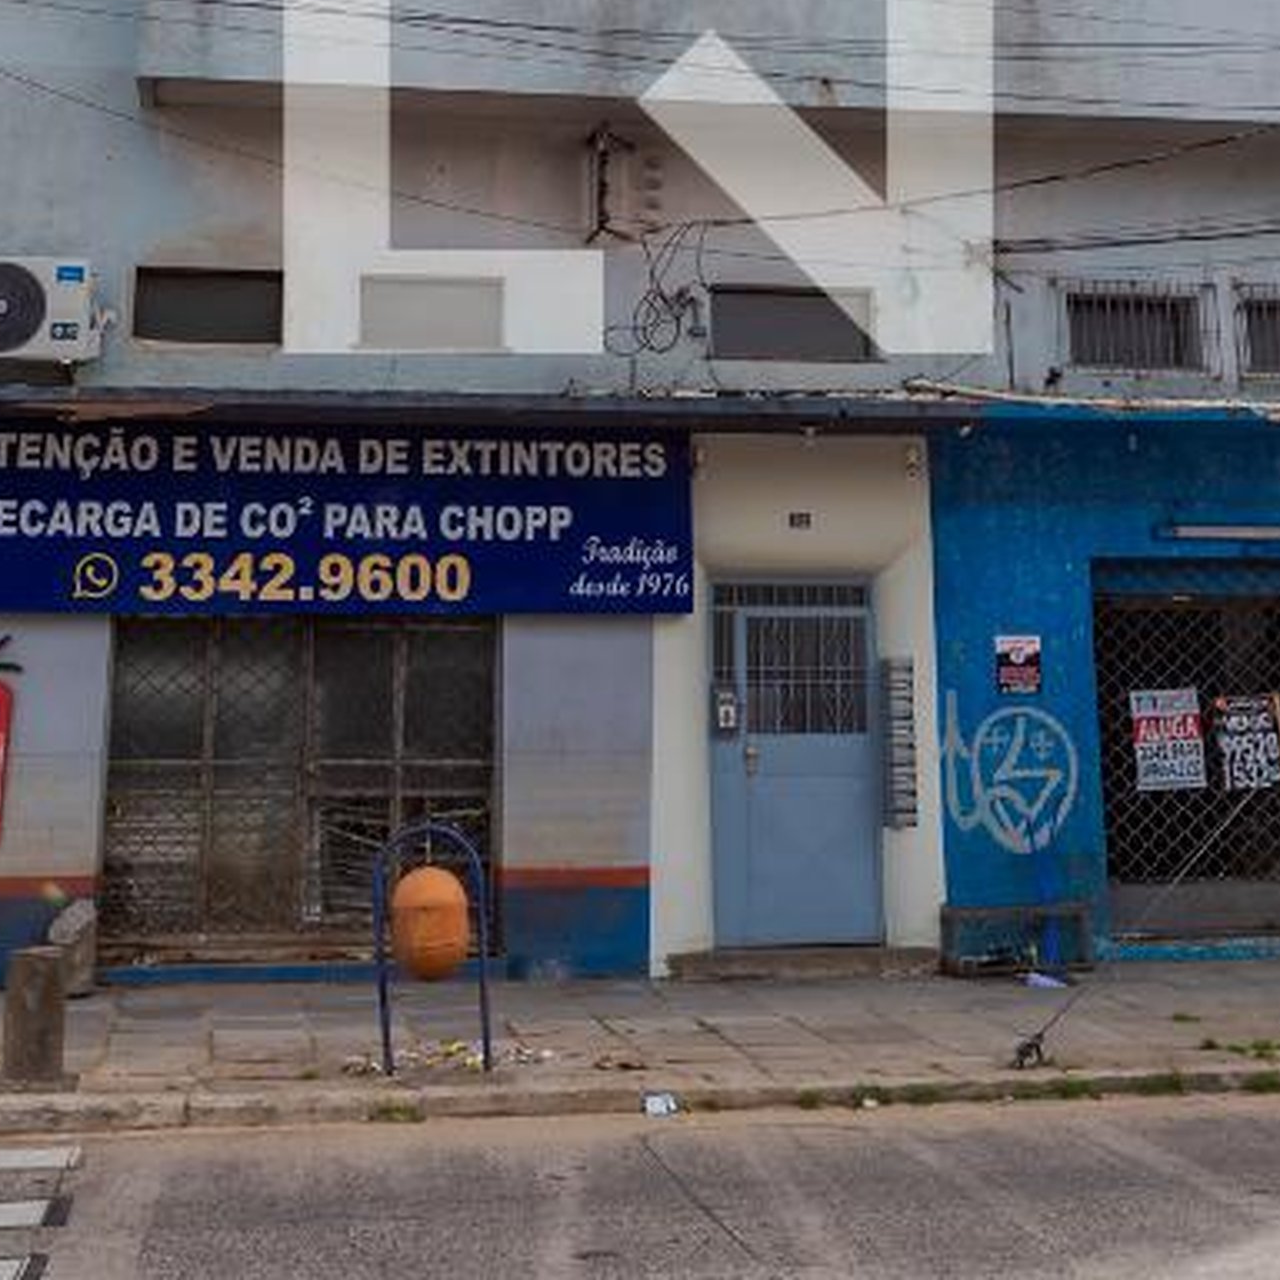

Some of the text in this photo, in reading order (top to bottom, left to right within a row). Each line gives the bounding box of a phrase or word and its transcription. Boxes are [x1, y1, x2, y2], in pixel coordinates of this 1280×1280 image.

[172, 437, 198, 472] E
[209, 436, 347, 474] VENDA
[358, 439, 410, 475] DE
[422, 439, 668, 478] EXTINTORES
[174, 502, 228, 539] DE
[323, 503, 428, 540] PARA
[439, 504, 574, 542] CHOPP
[582, 535, 678, 570] Tradição
[137, 551, 471, 602] 3342.9600
[569, 571, 689, 597] desde 1976
